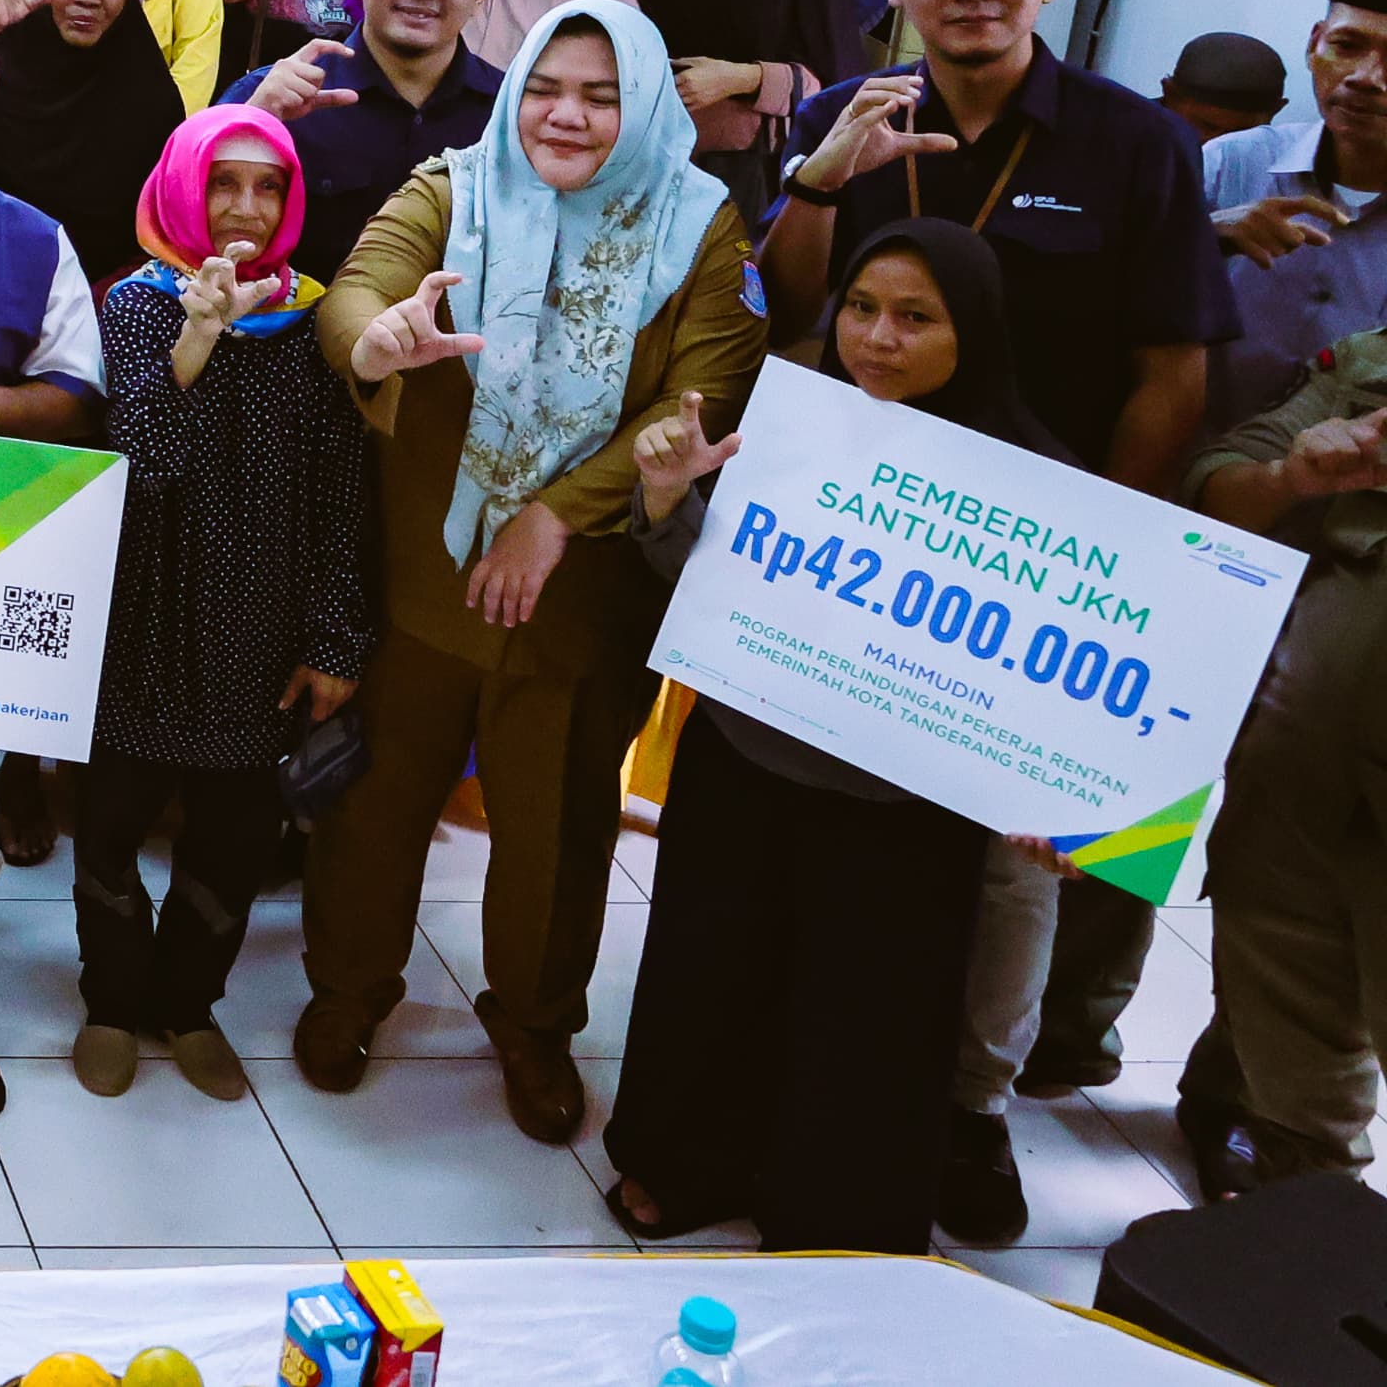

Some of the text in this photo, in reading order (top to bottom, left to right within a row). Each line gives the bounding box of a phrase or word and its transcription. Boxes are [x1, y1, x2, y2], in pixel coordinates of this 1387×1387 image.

[816, 481, 1152, 635] SANTUNAN JKM
[870, 462, 1119, 580] PEMBERIAN
[730, 501, 1191, 737] Rp42.000.000,-
[863, 642, 995, 711] MAHMUDIN
[729, 611, 814, 657] PROGRAM
[816, 649, 957, 721] PERLINDUNGAN
[961, 713, 1044, 759] PEKERJA
[1049, 751, 1130, 796] RENTAN
[736, 635, 844, 692] PEMERINTAH
[846, 685, 893, 715] KOTA
[899, 706, 1012, 767] TANGERANG
[1017, 760, 1104, 808] SELATAN
